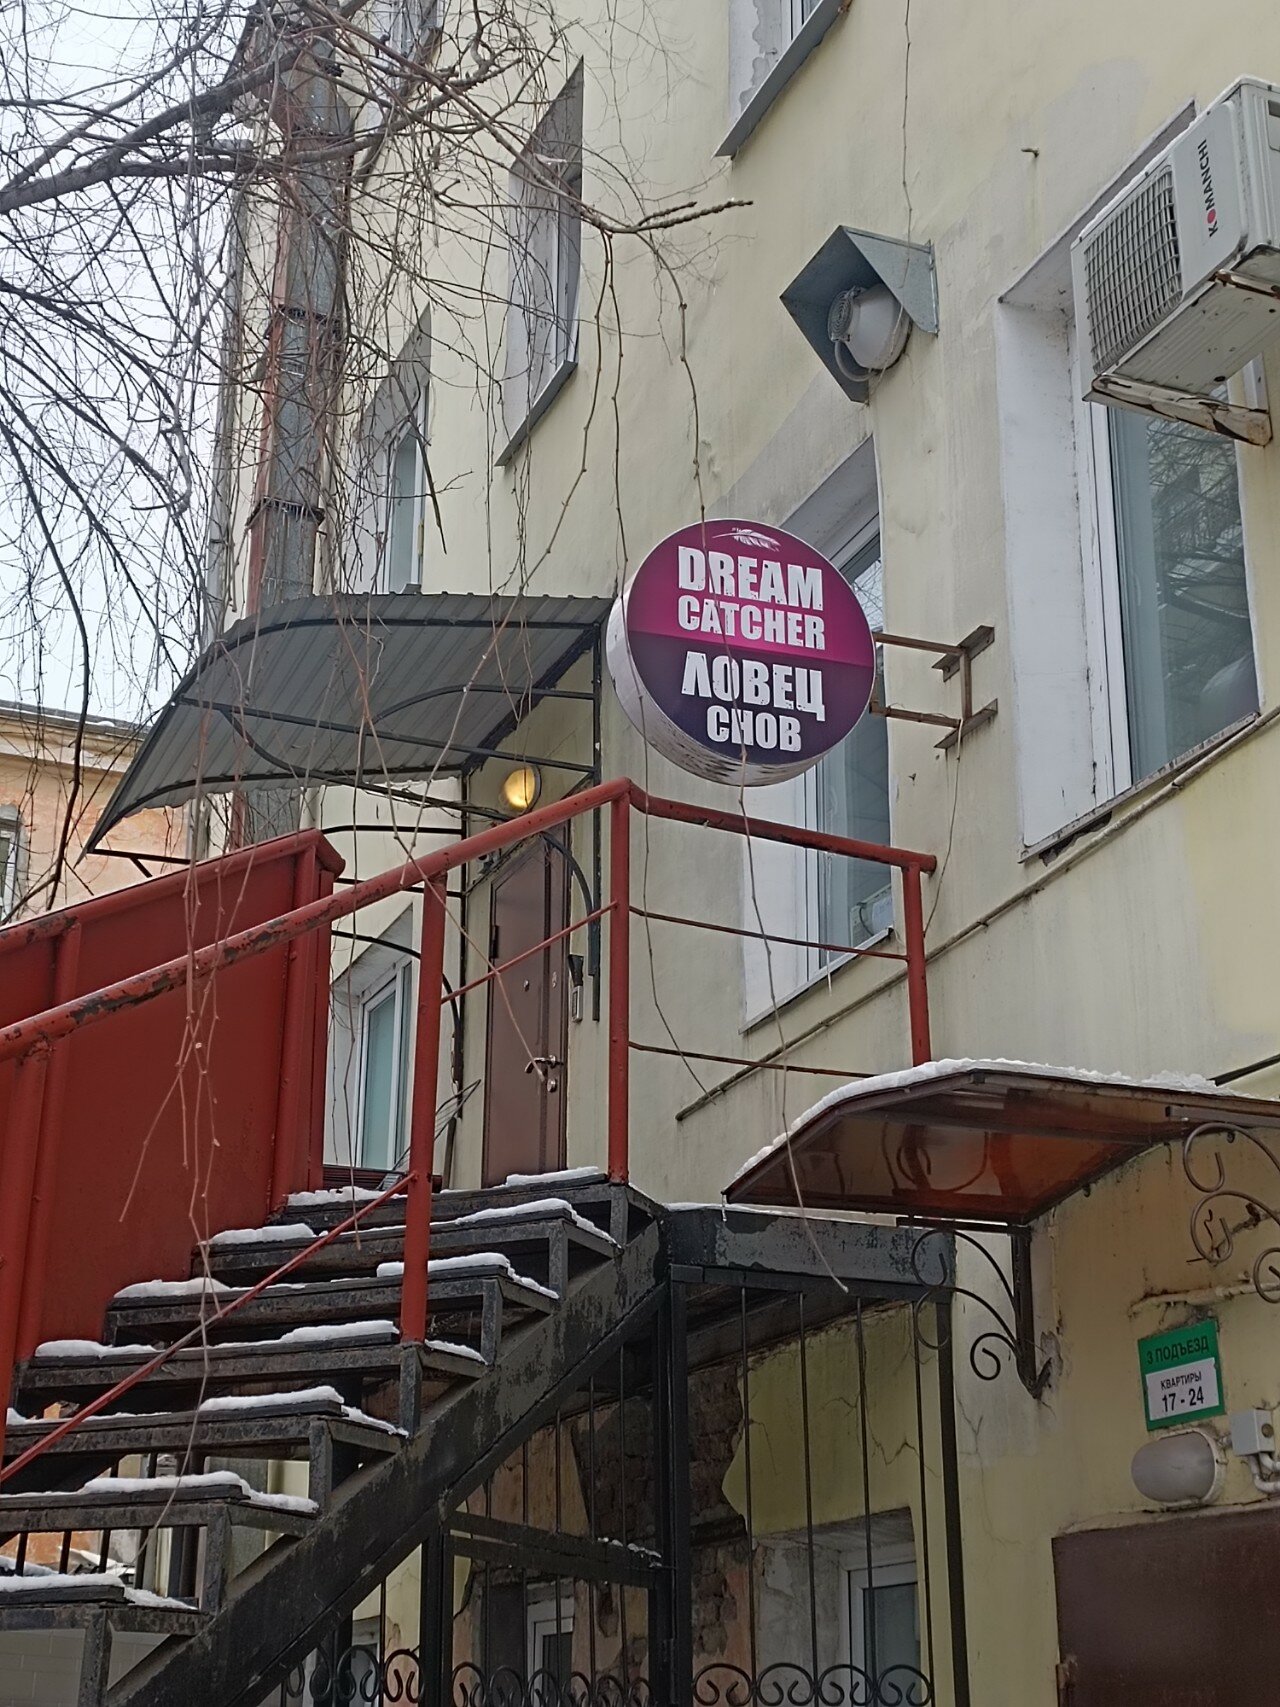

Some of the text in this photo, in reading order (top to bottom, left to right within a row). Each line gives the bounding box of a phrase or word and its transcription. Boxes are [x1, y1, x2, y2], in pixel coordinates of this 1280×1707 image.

[678, 545, 823, 611] DREAM
[678, 595, 825, 650] CATCHER
[681, 651, 825, 721] ЛОВЕЦ
[706, 705, 801, 752] СНОВ
[1146, 1336, 1209, 1364] 3 ПОДЪЕЗД
[1160, 1371, 1202, 1390] КВАРТИРЫ
[1162, 1393, 1176, 1412] 17
[1189, 1386, 1204, 1406] 24
